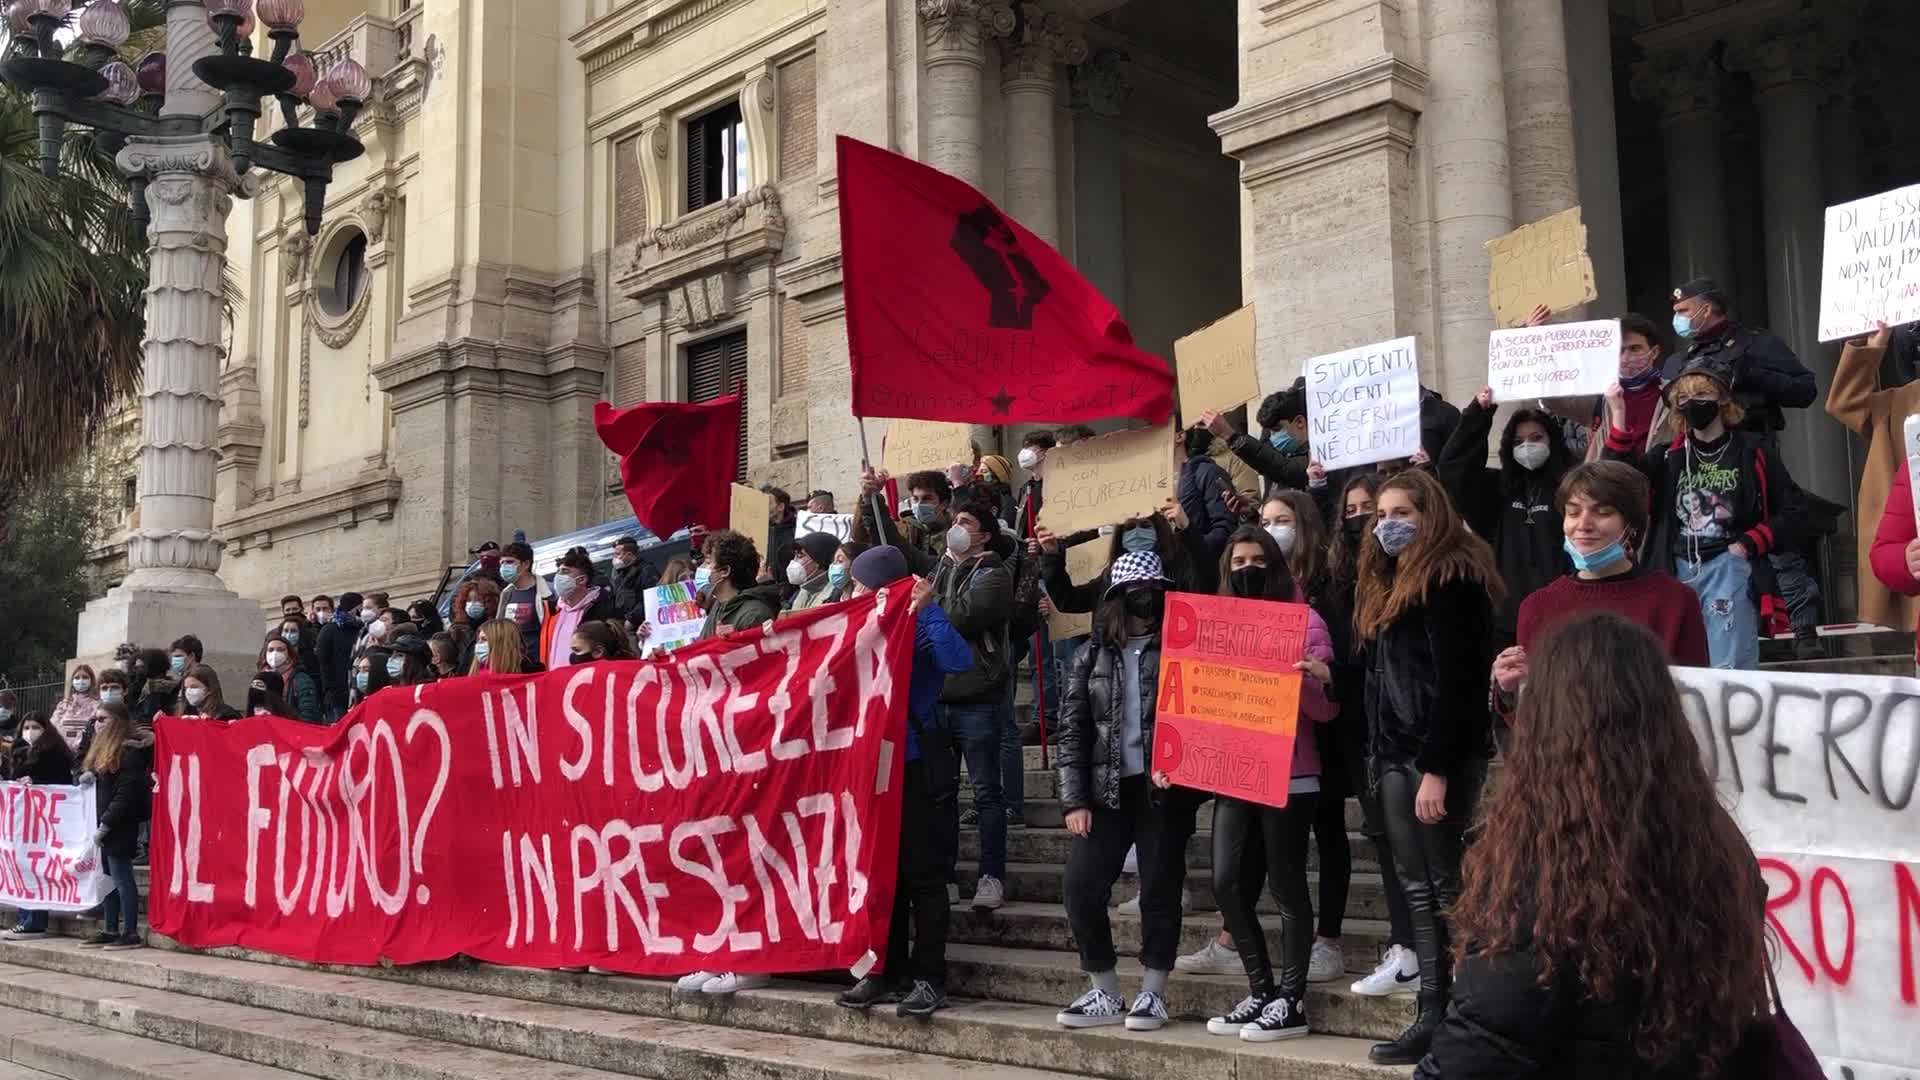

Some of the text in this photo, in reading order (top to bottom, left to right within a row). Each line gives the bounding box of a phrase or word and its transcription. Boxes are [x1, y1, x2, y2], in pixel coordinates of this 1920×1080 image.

[1490, 327, 1613, 350] LA SCUOLA PUBBLICA NON
[1316, 379, 1391, 409] DOCENTI
[1313, 402, 1399, 436] NÉ SERVI
[1316, 426, 1406, 462] NÉ CLIENTI
[1698, 463, 1718, 472] THE
[482, 608, 893, 792] IN SICUREZZA
[1158, 661, 1185, 715] A
[1154, 721, 1271, 796] DISTANZA
[168, 752, 216, 903] IL
[502, 829, 558, 949] IN
